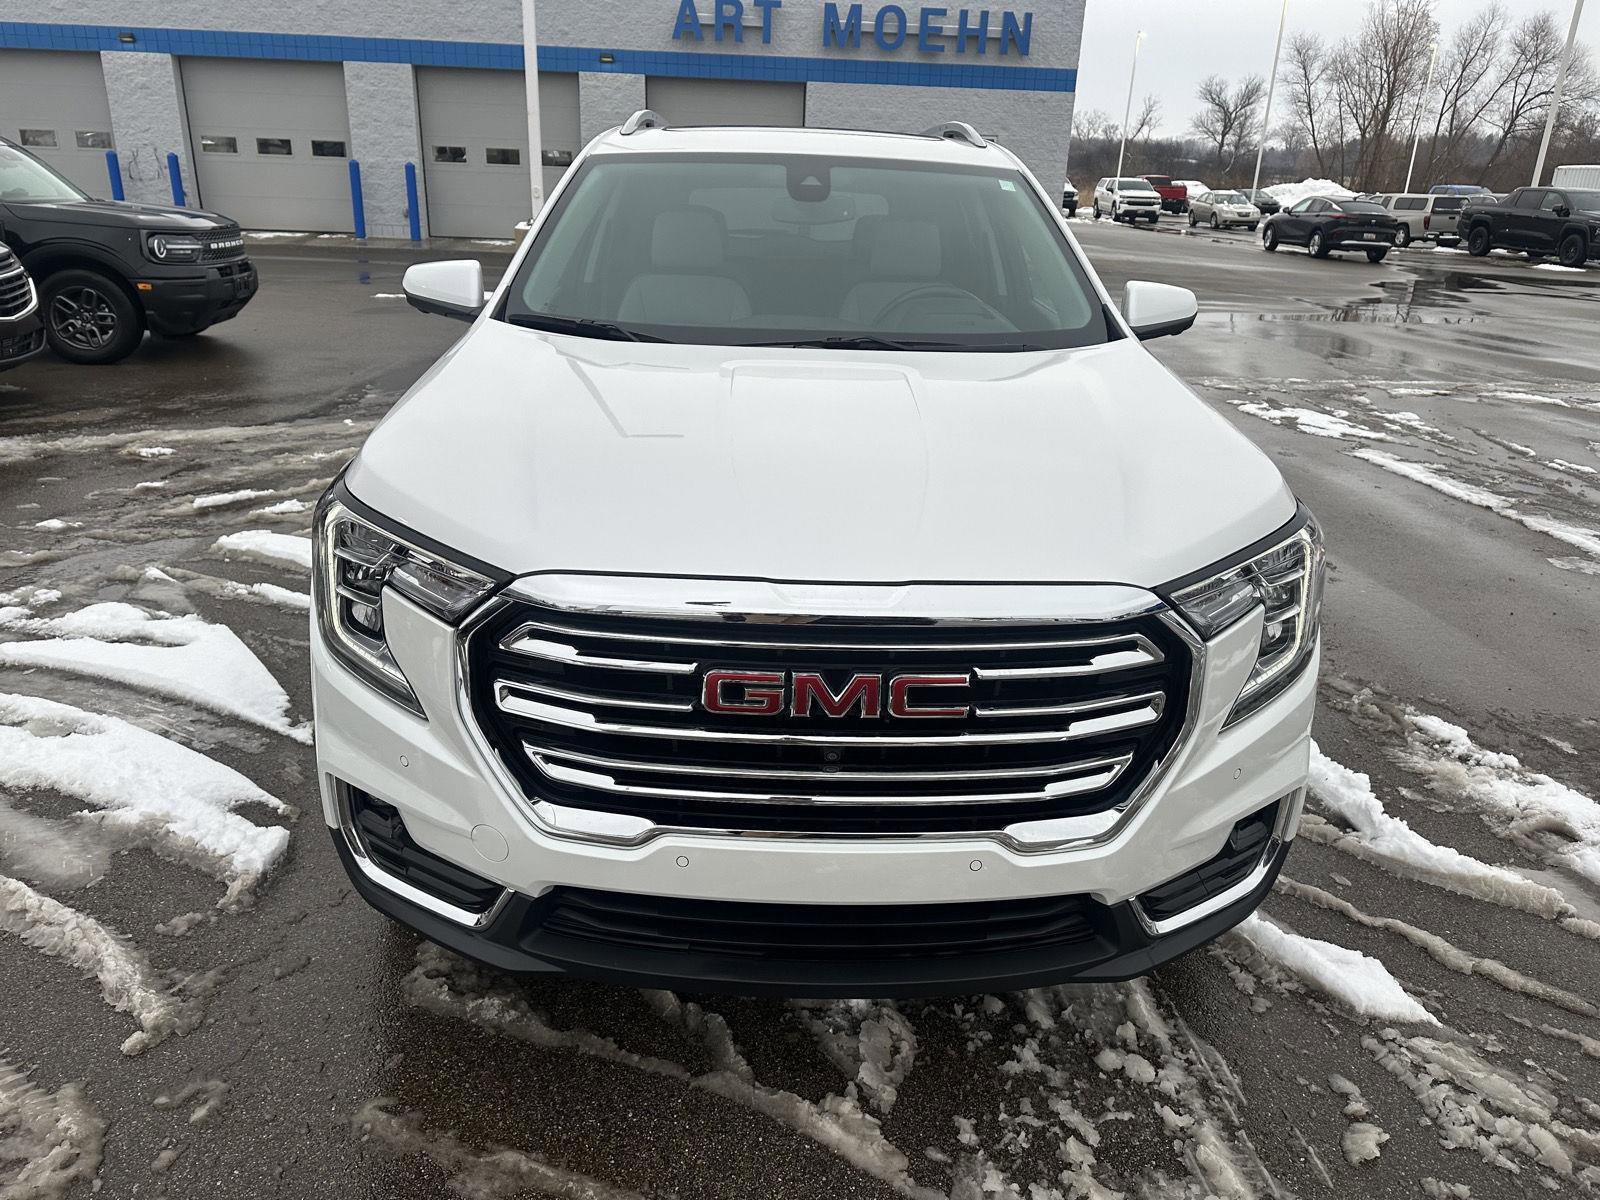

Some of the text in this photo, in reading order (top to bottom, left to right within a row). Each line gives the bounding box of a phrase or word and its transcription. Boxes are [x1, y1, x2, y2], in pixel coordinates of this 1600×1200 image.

[672, 0, 1033, 56] ART MOEHN
[702, 669, 970, 718] GMC
